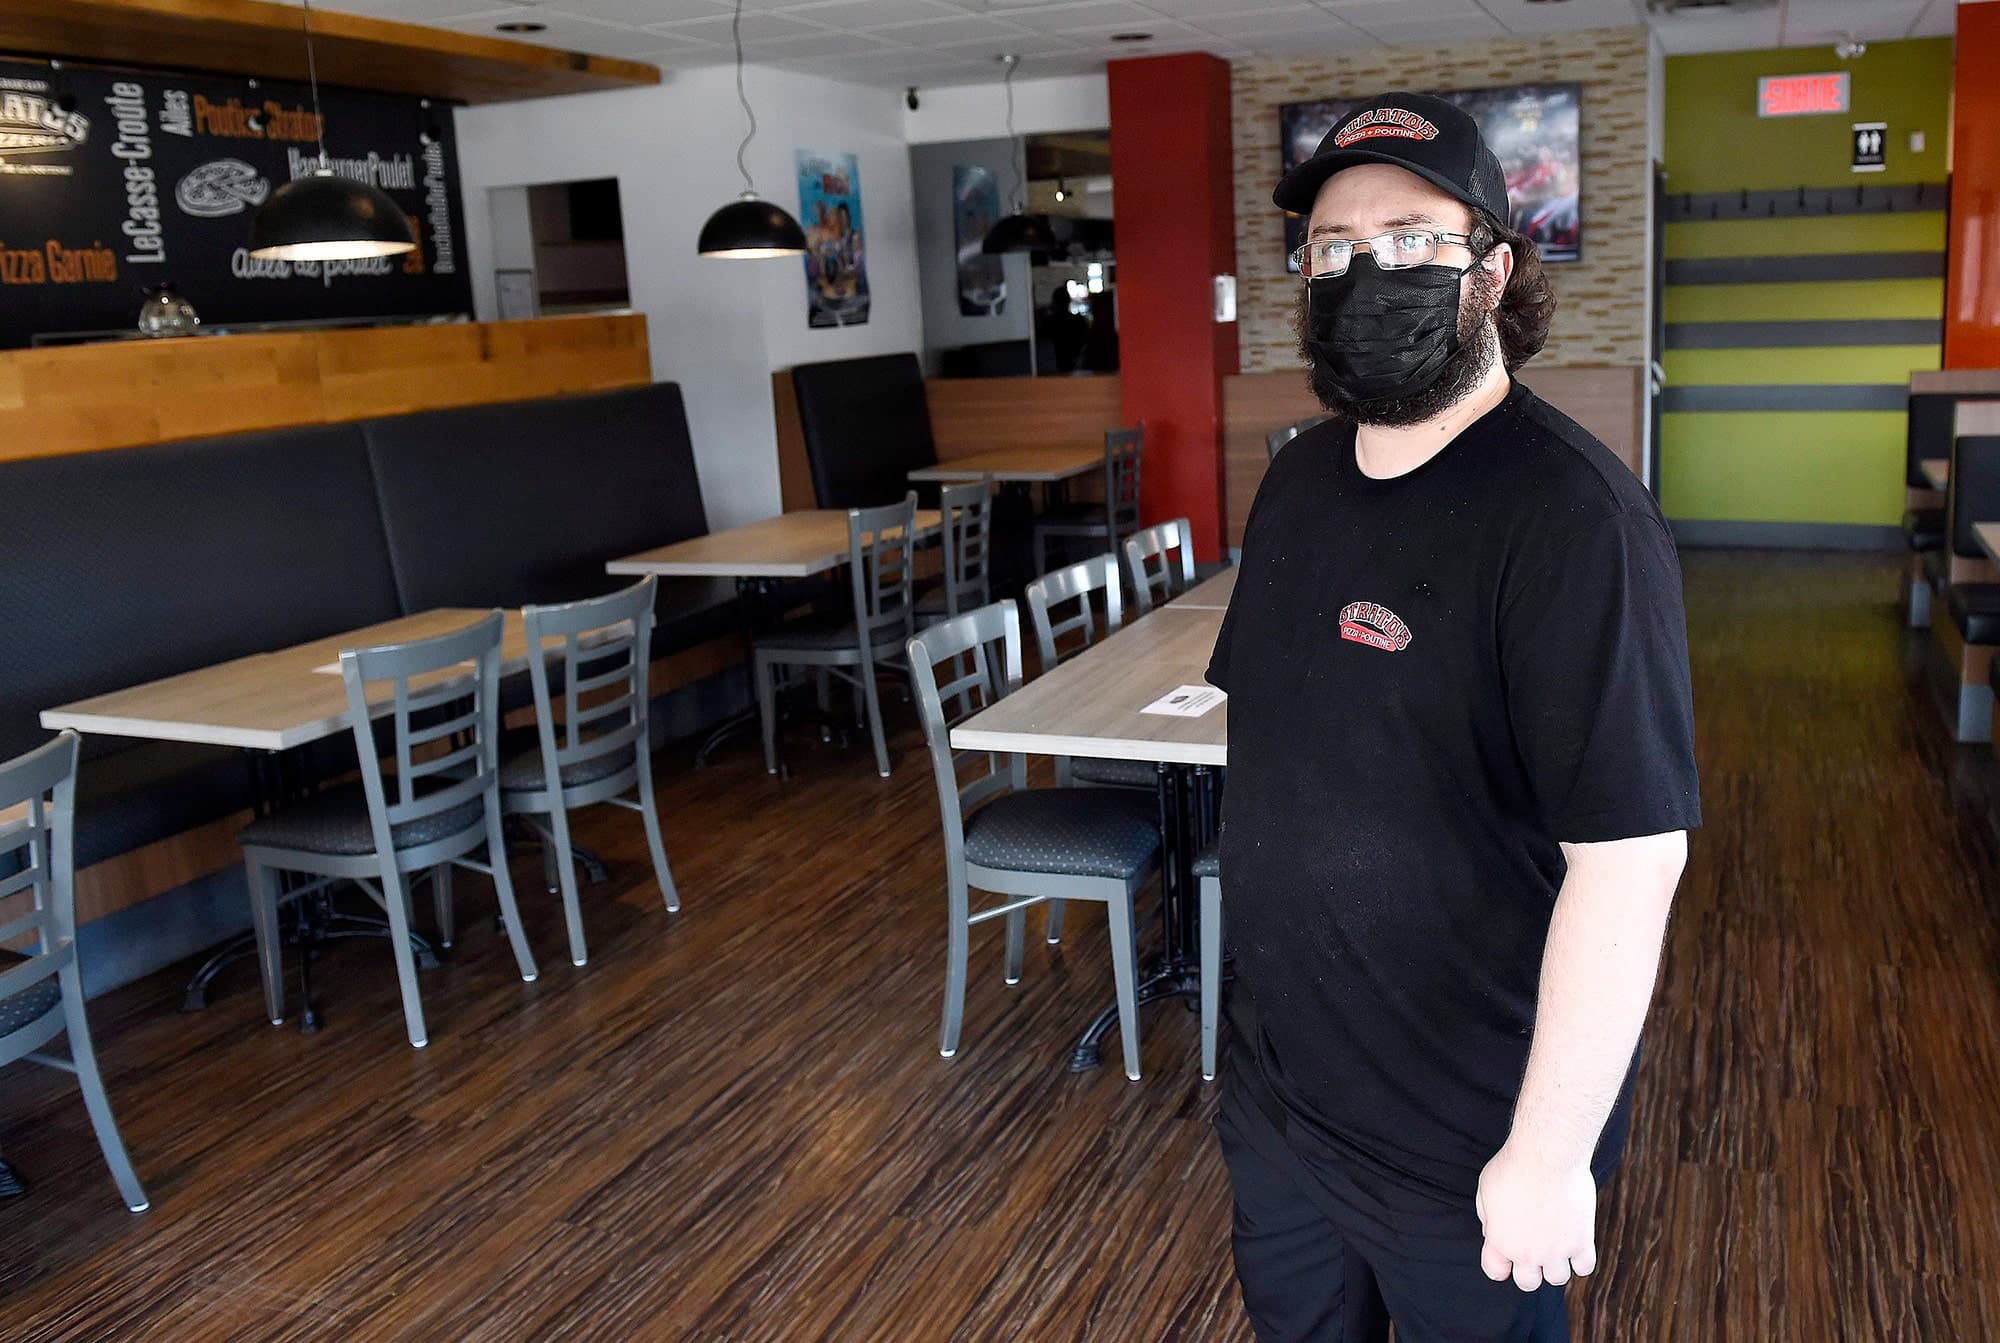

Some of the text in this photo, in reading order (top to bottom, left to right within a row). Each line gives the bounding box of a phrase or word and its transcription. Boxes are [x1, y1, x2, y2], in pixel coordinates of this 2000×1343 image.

[1335, 108, 1439, 145] STRATOS
[1374, 128, 1416, 138] POUTINE
[0, 240, 46, 284] izza
[1339, 601, 1413, 651] STRATOS
[1361, 631, 1391, 648] POUTINE
